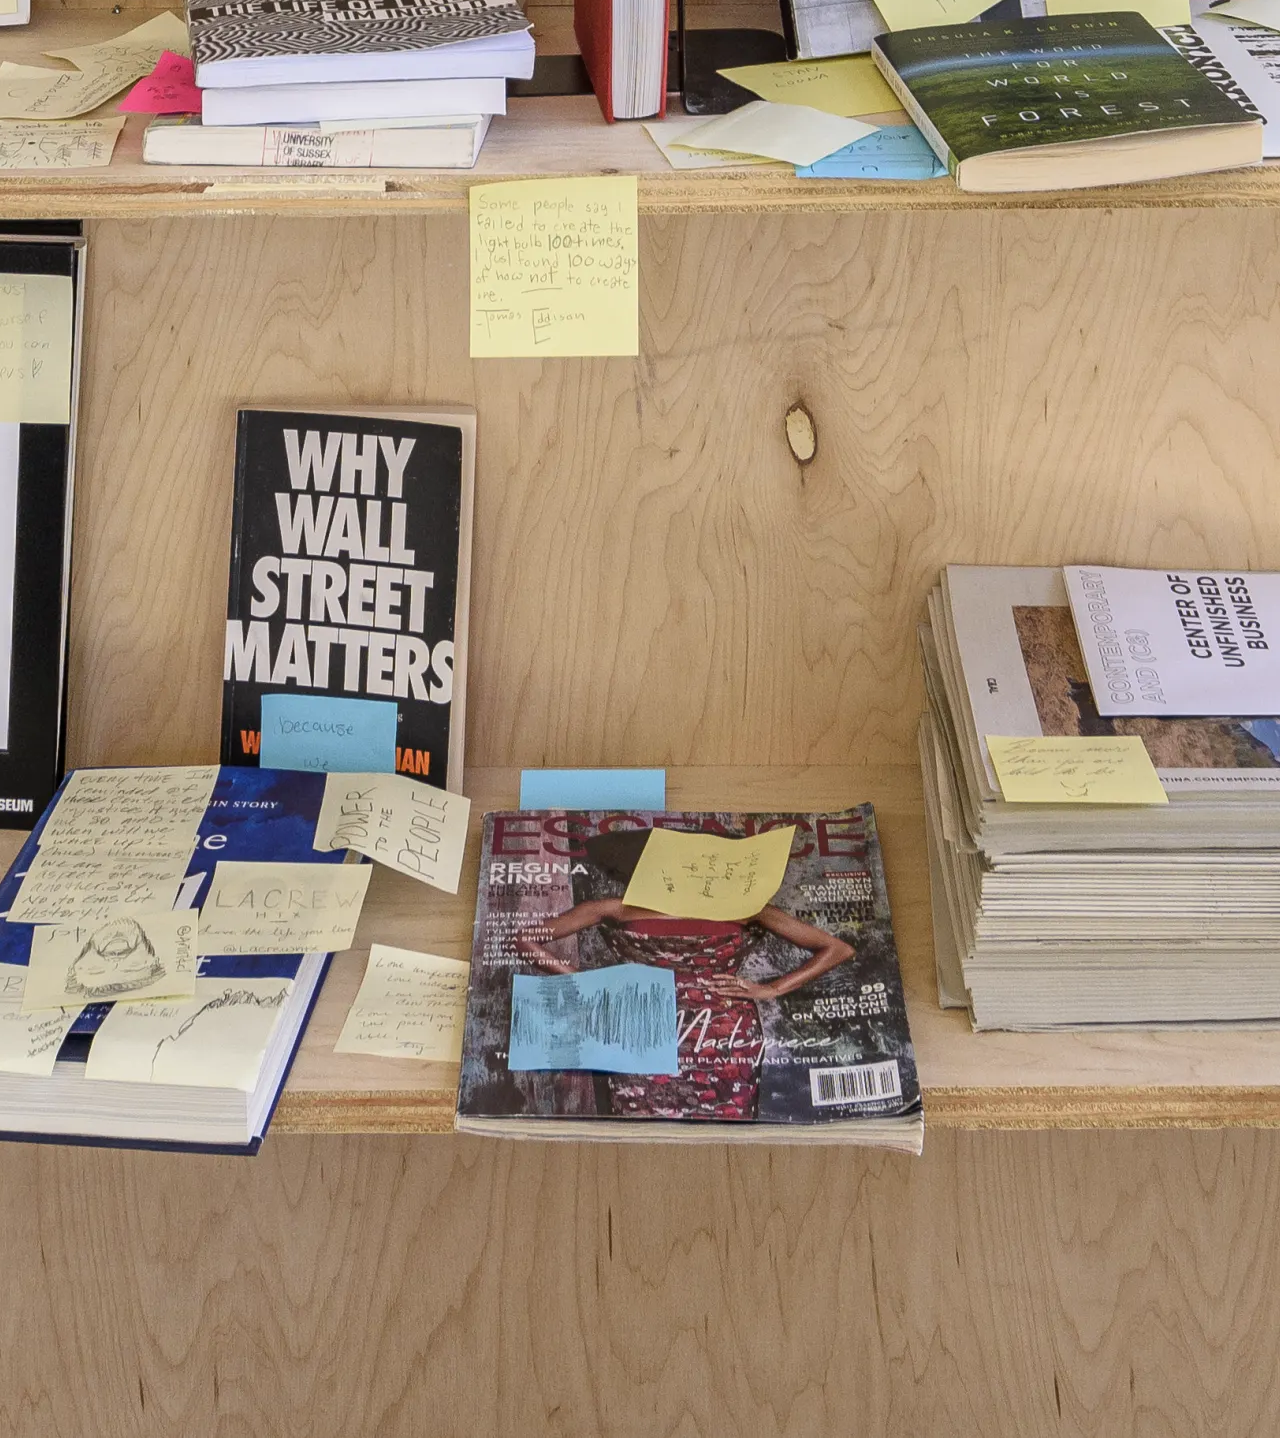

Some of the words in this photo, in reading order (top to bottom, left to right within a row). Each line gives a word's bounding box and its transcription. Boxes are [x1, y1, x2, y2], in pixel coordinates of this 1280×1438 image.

[207, 4, 271, 17] THE
[274, 0, 343, 13] LIFE
[330, 10, 381, 21] TIM
[386, 0, 487, 18] INGOLD
[913, 29, 992, 43] URSULA
[1004, 28, 1023, 37] K.
[1037, 25, 1059, 34] LE
[1071, 20, 1120, 31] GUIN
[963, 50, 1006, 59] THE
[1030, 43, 1103, 54] WORD
[1013, 59, 1079, 69] FOR
[987, 71, 1129, 88] WORLD
[1056, 90, 1091, 100] IS
[981, 98, 1193, 127] FOREST
[282, 133, 335, 146] UNIVERSITY
[283, 147, 294, 157] OF
[296, 147, 331, 158] SUSSEX
[283, 429, 416, 498] WHY
[274, 492, 415, 566] WALL
[251, 556, 434, 633] STREET
[1166, 574, 1192, 596] OF
[1197, 576, 1246, 667] UNFINISHED
[1231, 576, 1268, 651] BUSINESS
[1166, 599, 1213, 660] CENTER
[223, 619, 455, 705] MATTERS
[489, 873, 553, 884] KING
[490, 863, 589, 875] REGINA
